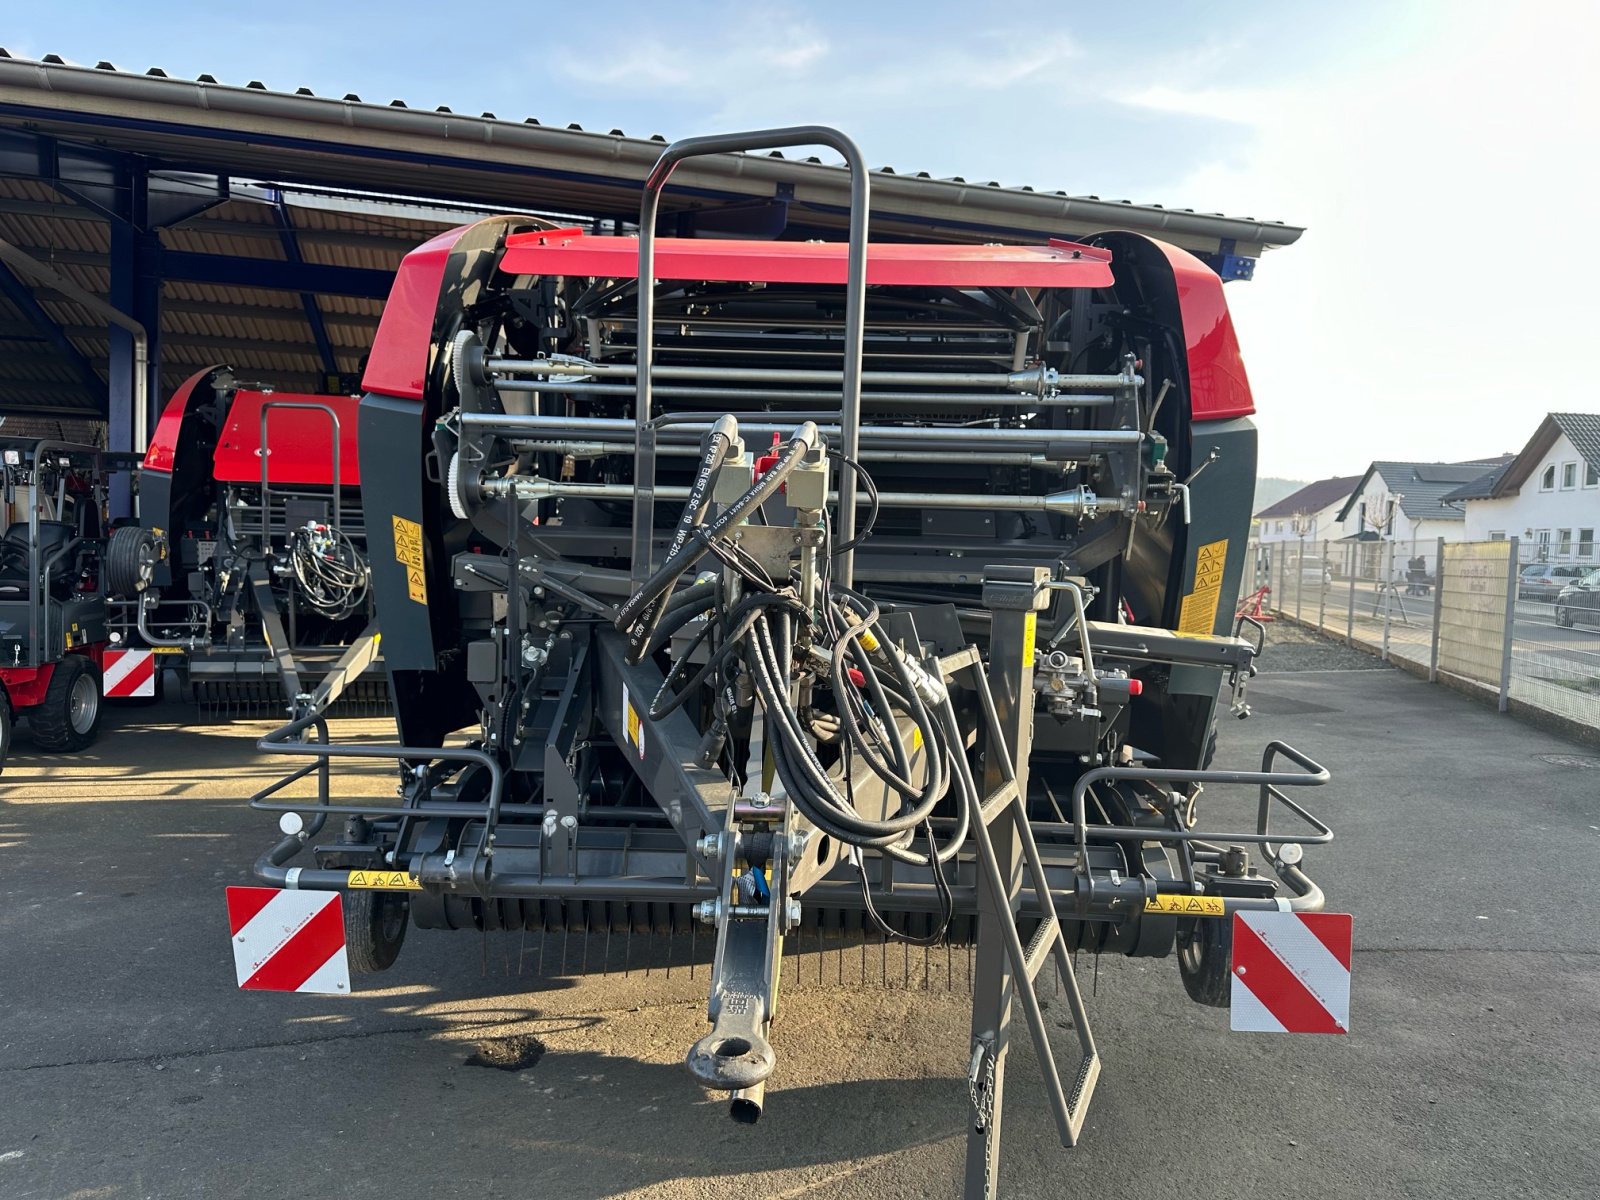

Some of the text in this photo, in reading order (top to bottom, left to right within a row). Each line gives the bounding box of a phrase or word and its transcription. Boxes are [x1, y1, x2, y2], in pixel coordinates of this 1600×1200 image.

[700, 467, 711, 478] EN
[765, 470, 778, 482] BAR
[696, 478, 707, 491] 857
[749, 481, 766, 496] MSHA
[683, 515, 693, 524] 19
[712, 516, 728, 530] 4Q21
[676, 529, 687, 544] WP
[669, 542, 681, 556] 215
[634, 623, 645, 637] 4Q21
